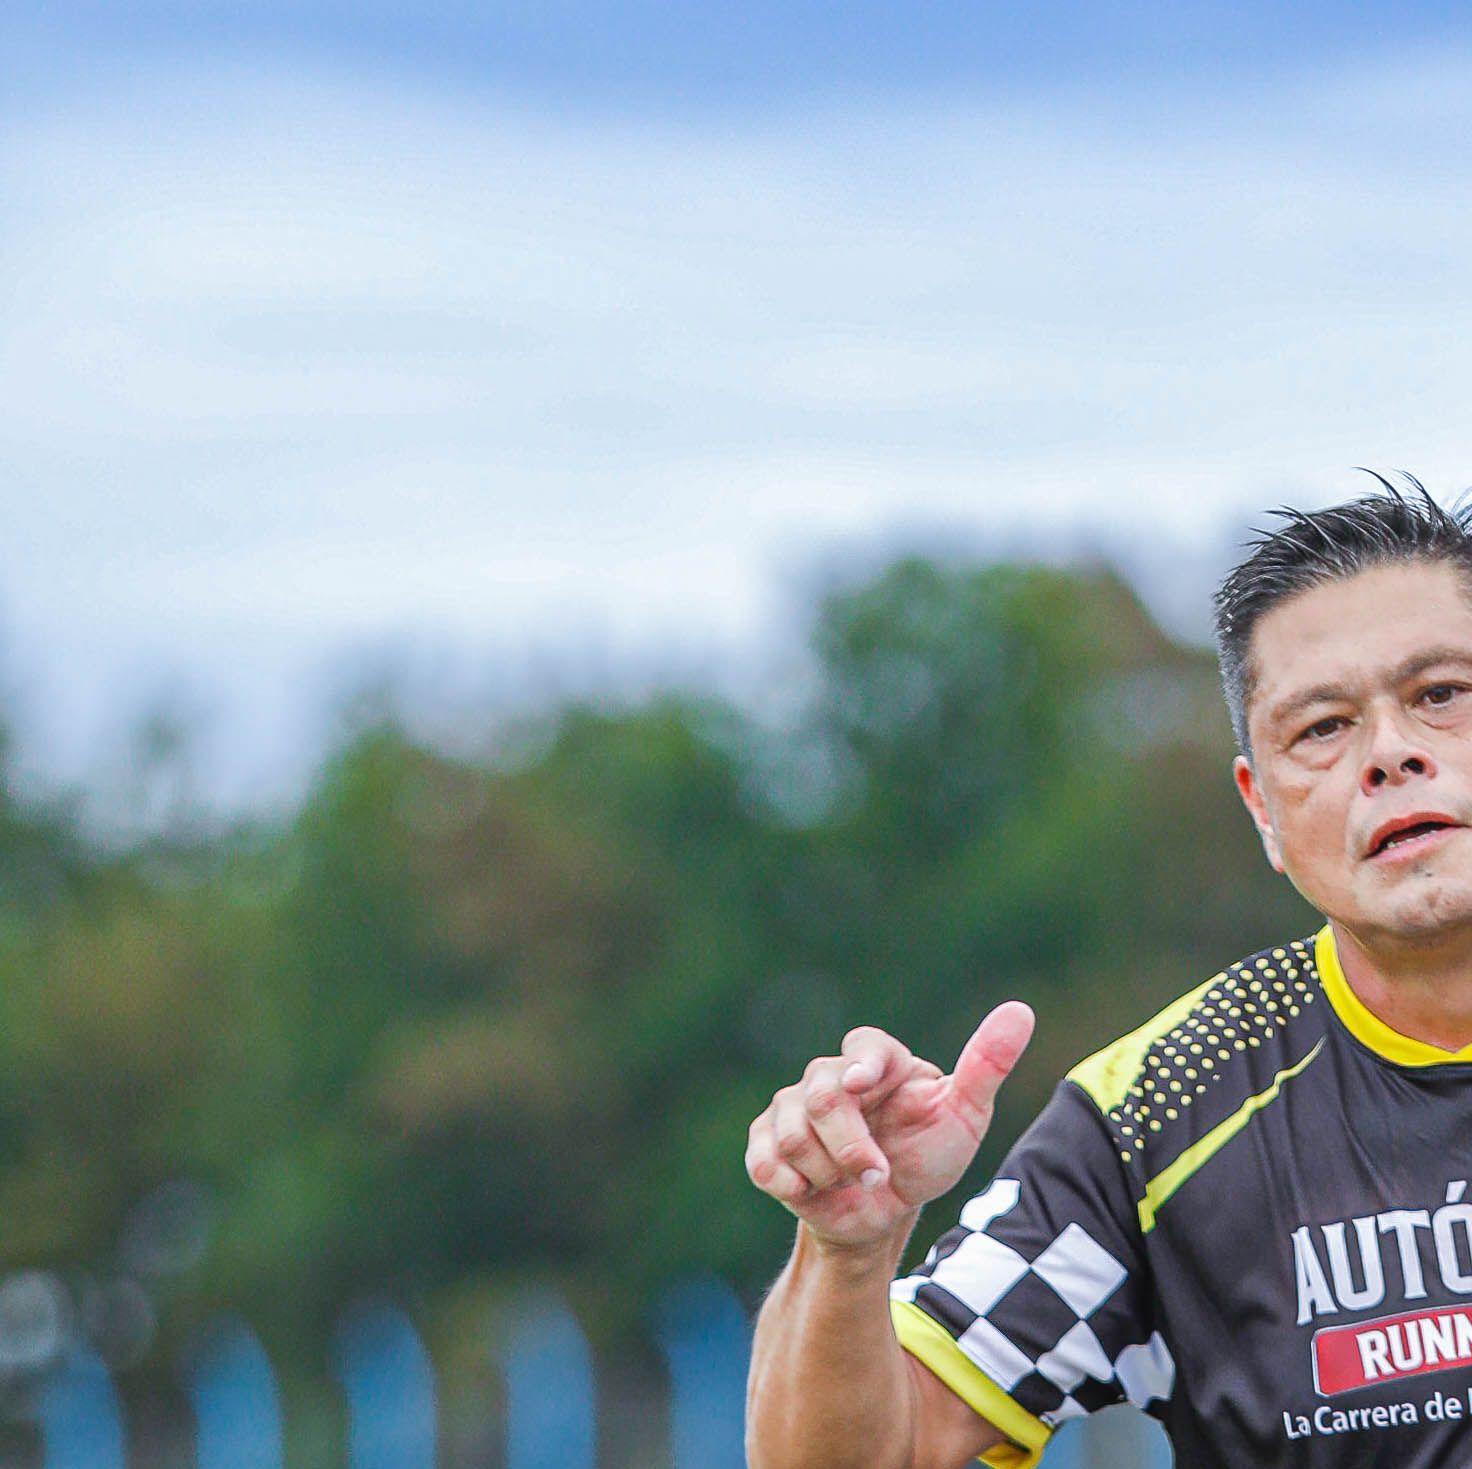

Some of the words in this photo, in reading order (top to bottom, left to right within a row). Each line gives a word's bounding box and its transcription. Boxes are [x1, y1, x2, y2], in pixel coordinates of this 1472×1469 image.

[1283, 1410, 1312, 1440] La
[1313, 1403, 1419, 1436] Carrera
[1423, 1391, 1463, 1422] de
